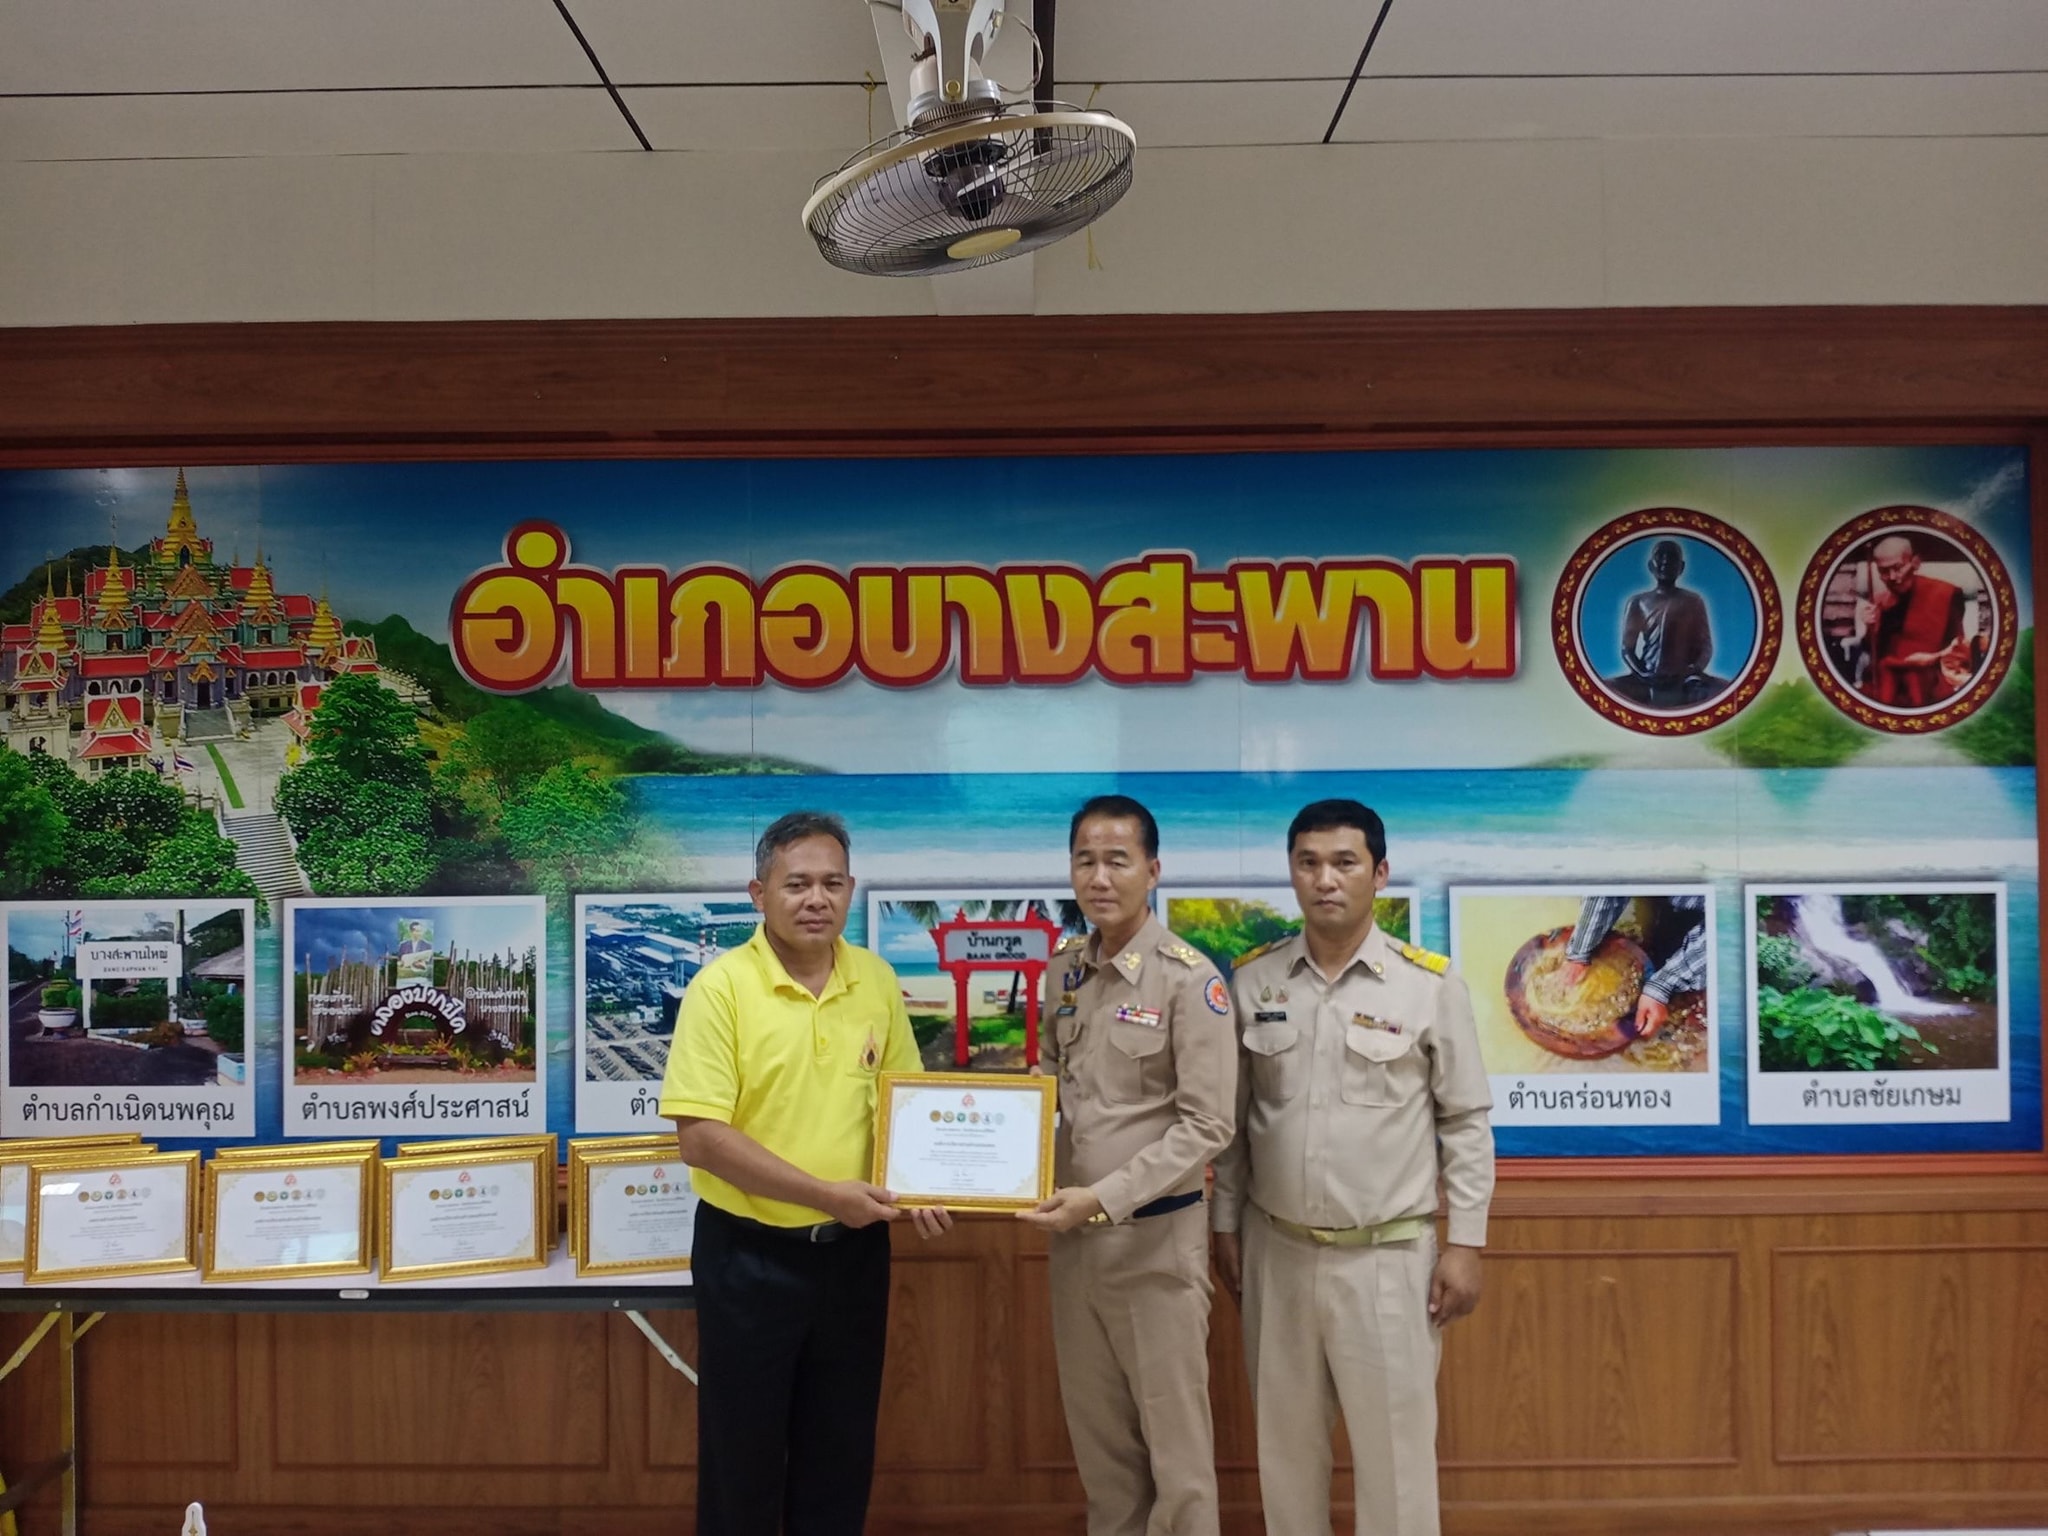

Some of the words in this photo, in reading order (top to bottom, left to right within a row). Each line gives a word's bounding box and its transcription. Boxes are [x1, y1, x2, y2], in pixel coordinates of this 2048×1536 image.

[453, 523, 1513, 689] อำเภอบางสะพาน
[91, 945, 168, 963] บางสะพานใหญ่
[967, 931, 1022, 952] บ้านกรูด
[967, 952, 992, 960] BAAN
[302, 1088, 530, 1120] ตำบลพงศ์ประศาสน์
[1509, 1081, 1671, 1109] ตำบลร่อนทอง
[1803, 1079, 1961, 1108] ตำบลชัยเกษม
[22, 1093, 235, 1130] ตำบลกำเนิดนพคุณ
